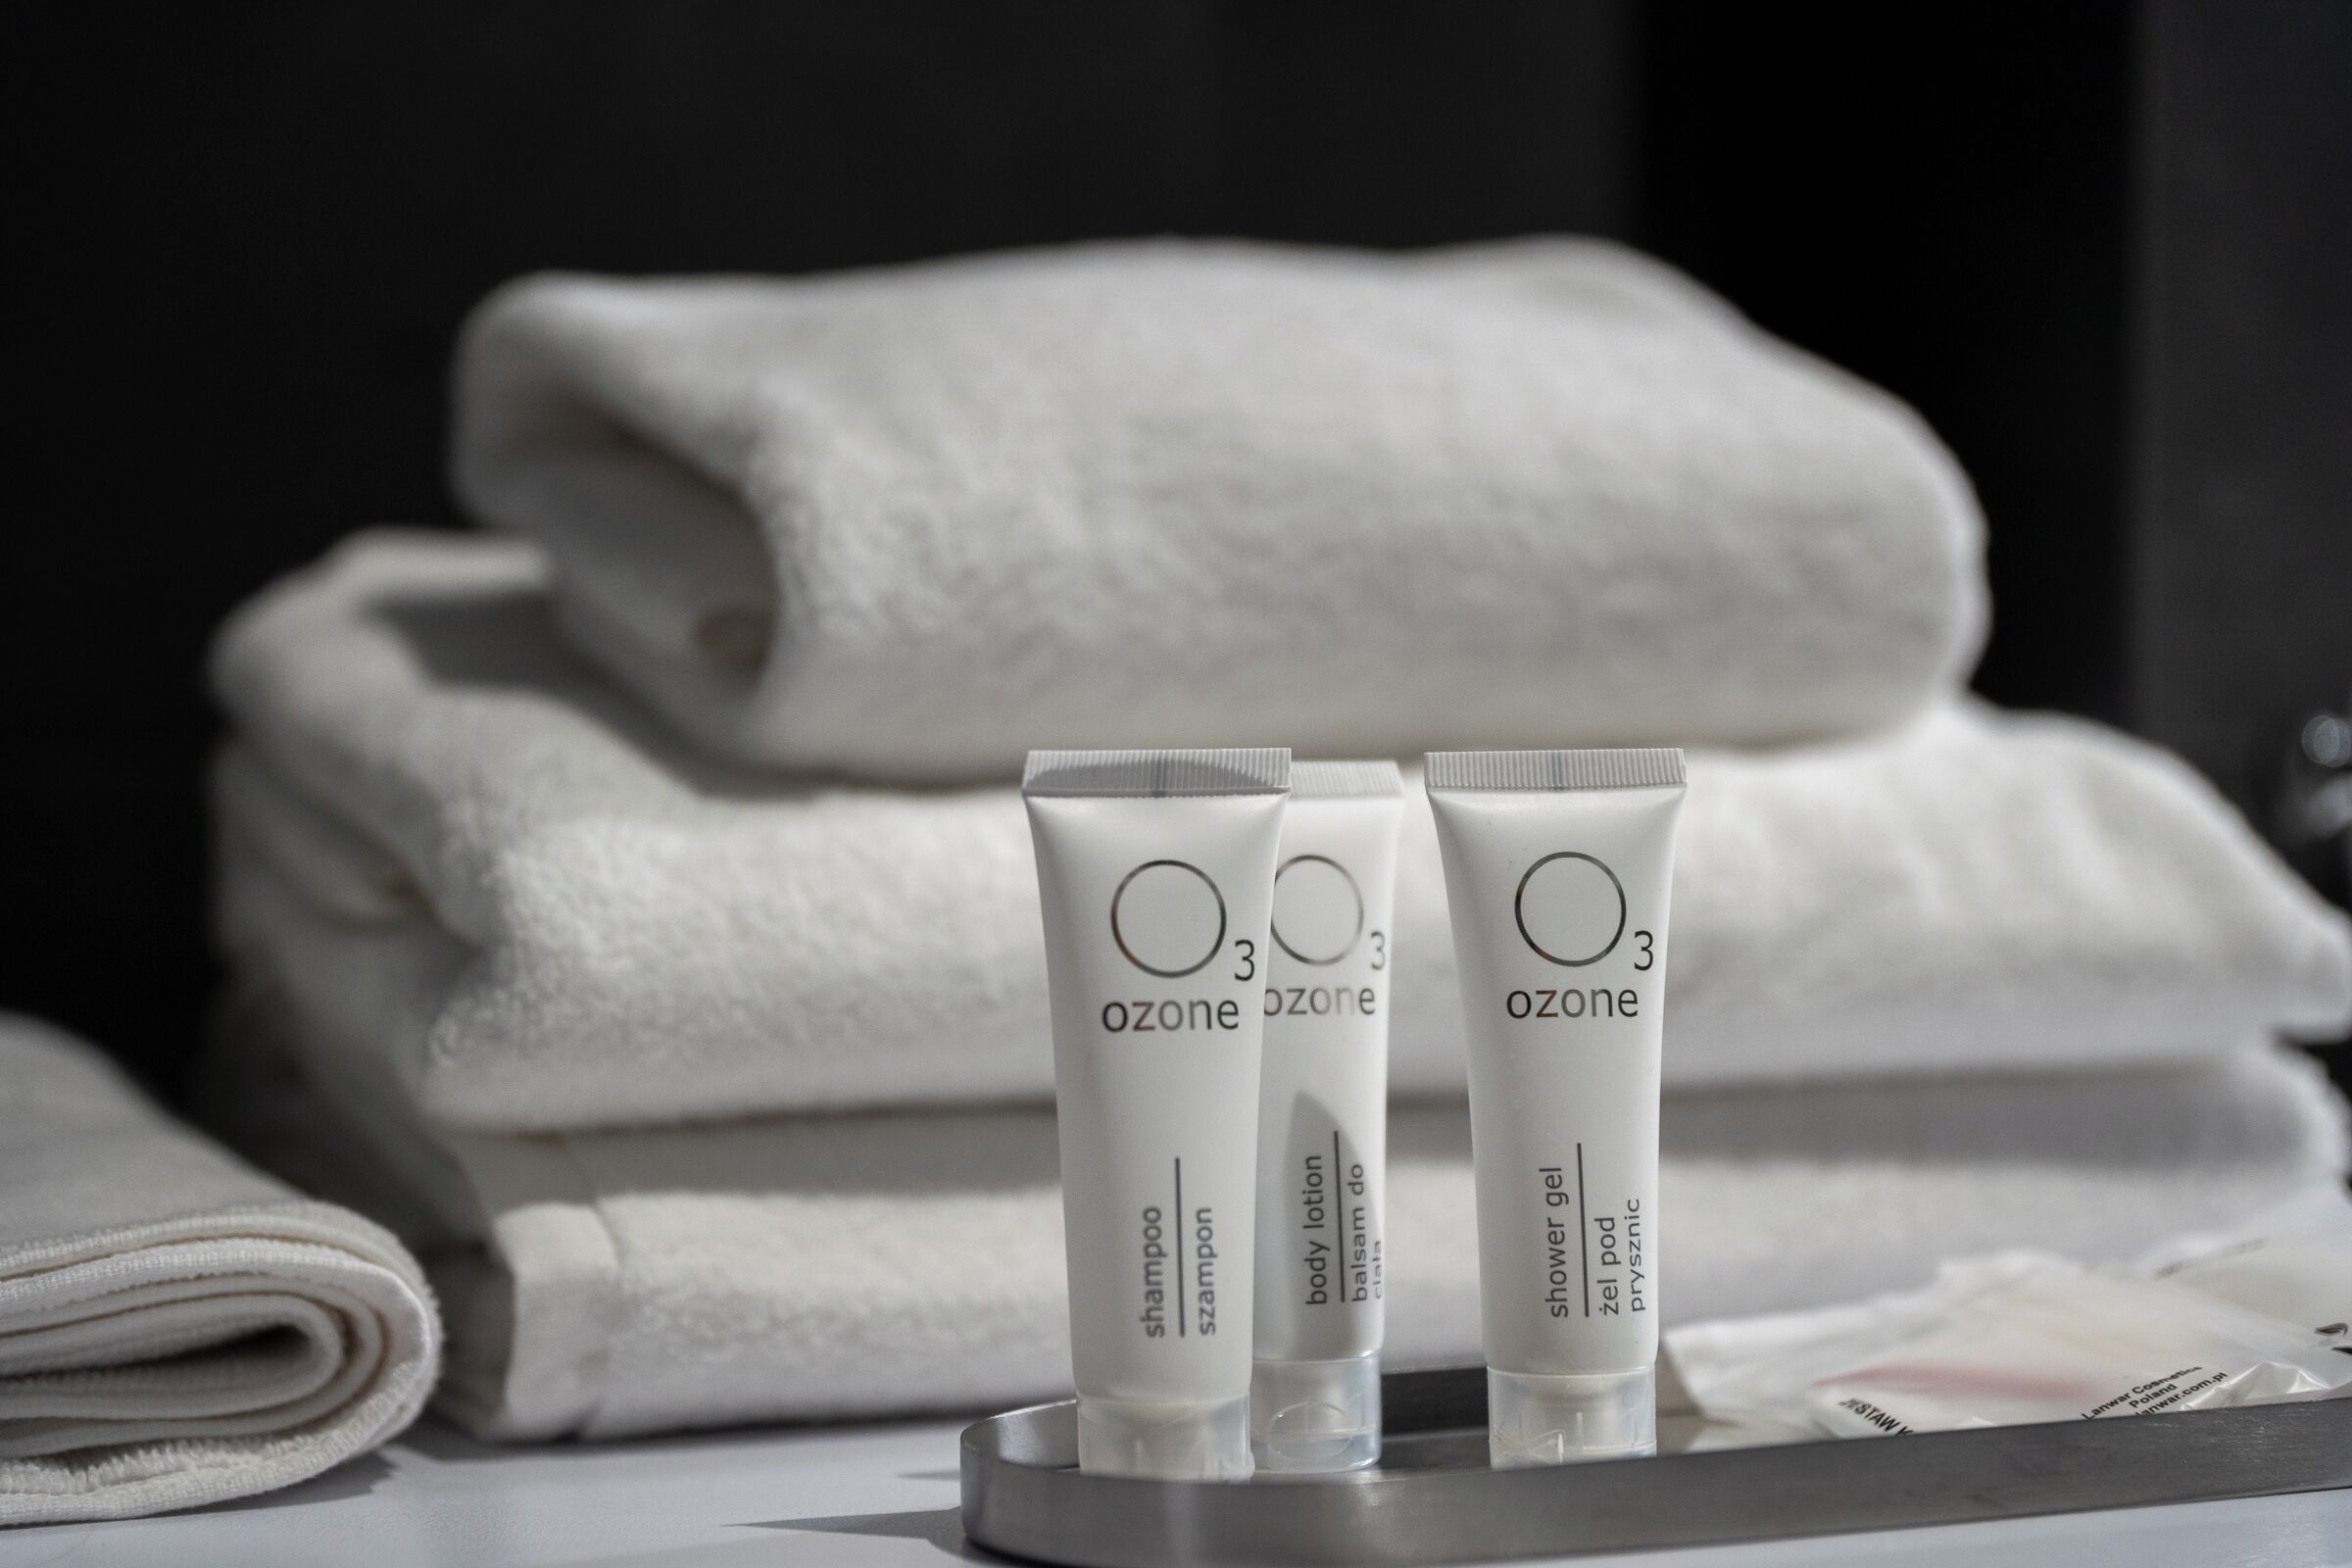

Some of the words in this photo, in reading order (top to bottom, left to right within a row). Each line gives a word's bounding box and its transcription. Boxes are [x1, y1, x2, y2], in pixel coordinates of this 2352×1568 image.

[1102, 993, 1240, 1033] ozone
[1264, 986, 1376, 1017] ozone
[1506, 983, 1640, 1019] ozone
[1301, 1154, 1325, 1229] lotion
[1347, 1163, 1365, 1196] do
[1539, 1167, 1570, 1207] gel
[1349, 1206, 1368, 1302] balsam
[1593, 1217, 1622, 1267] pod
[1624, 1199, 1646, 1312] prysznic
[1140, 1205, 1167, 1339] shampoo
[1195, 1206, 1218, 1336] szampon
[1303, 1240, 1331, 1305] body
[1544, 1217, 1569, 1318] shower
[1597, 1278, 1619, 1316] żel
[2081, 1392, 2132, 1420] Lanwar
[2129, 1383, 2179, 1408] Poland
